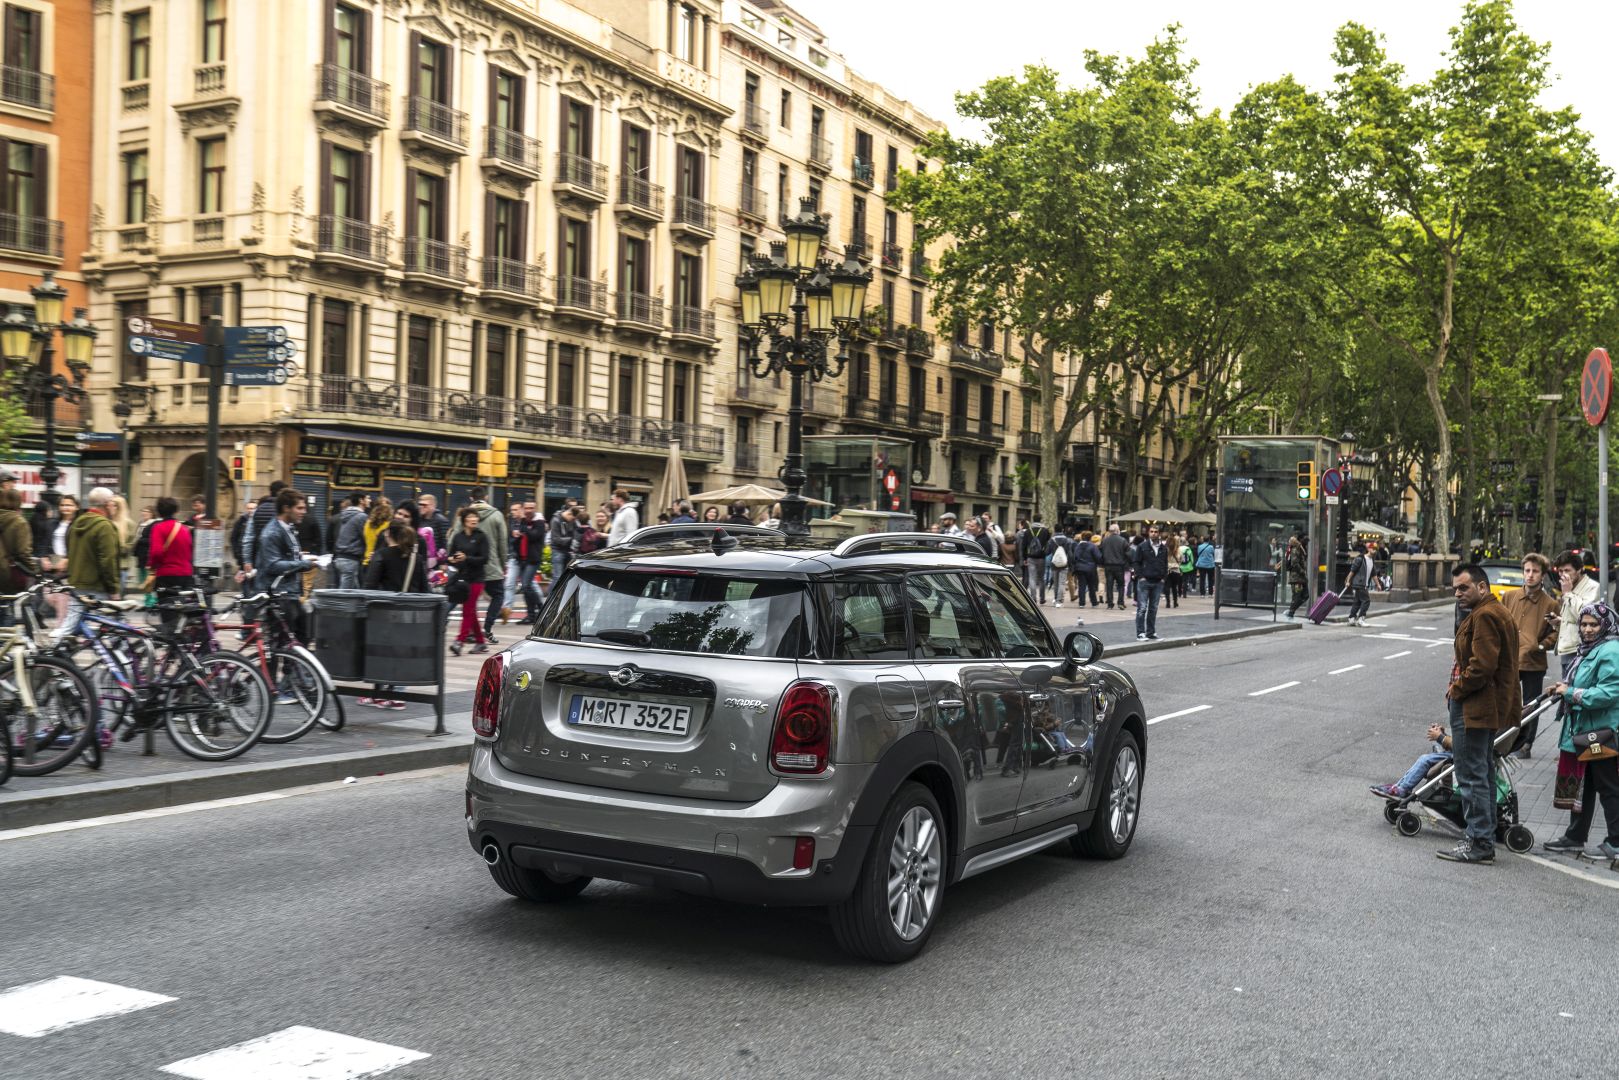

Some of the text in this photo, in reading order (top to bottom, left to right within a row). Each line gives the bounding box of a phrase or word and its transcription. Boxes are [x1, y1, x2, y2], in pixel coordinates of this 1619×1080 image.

[581, 699, 688, 732] M RT 352E
[724, 697, 762, 708] COOPER
[523, 745, 727, 777] COUNTRYMAN
